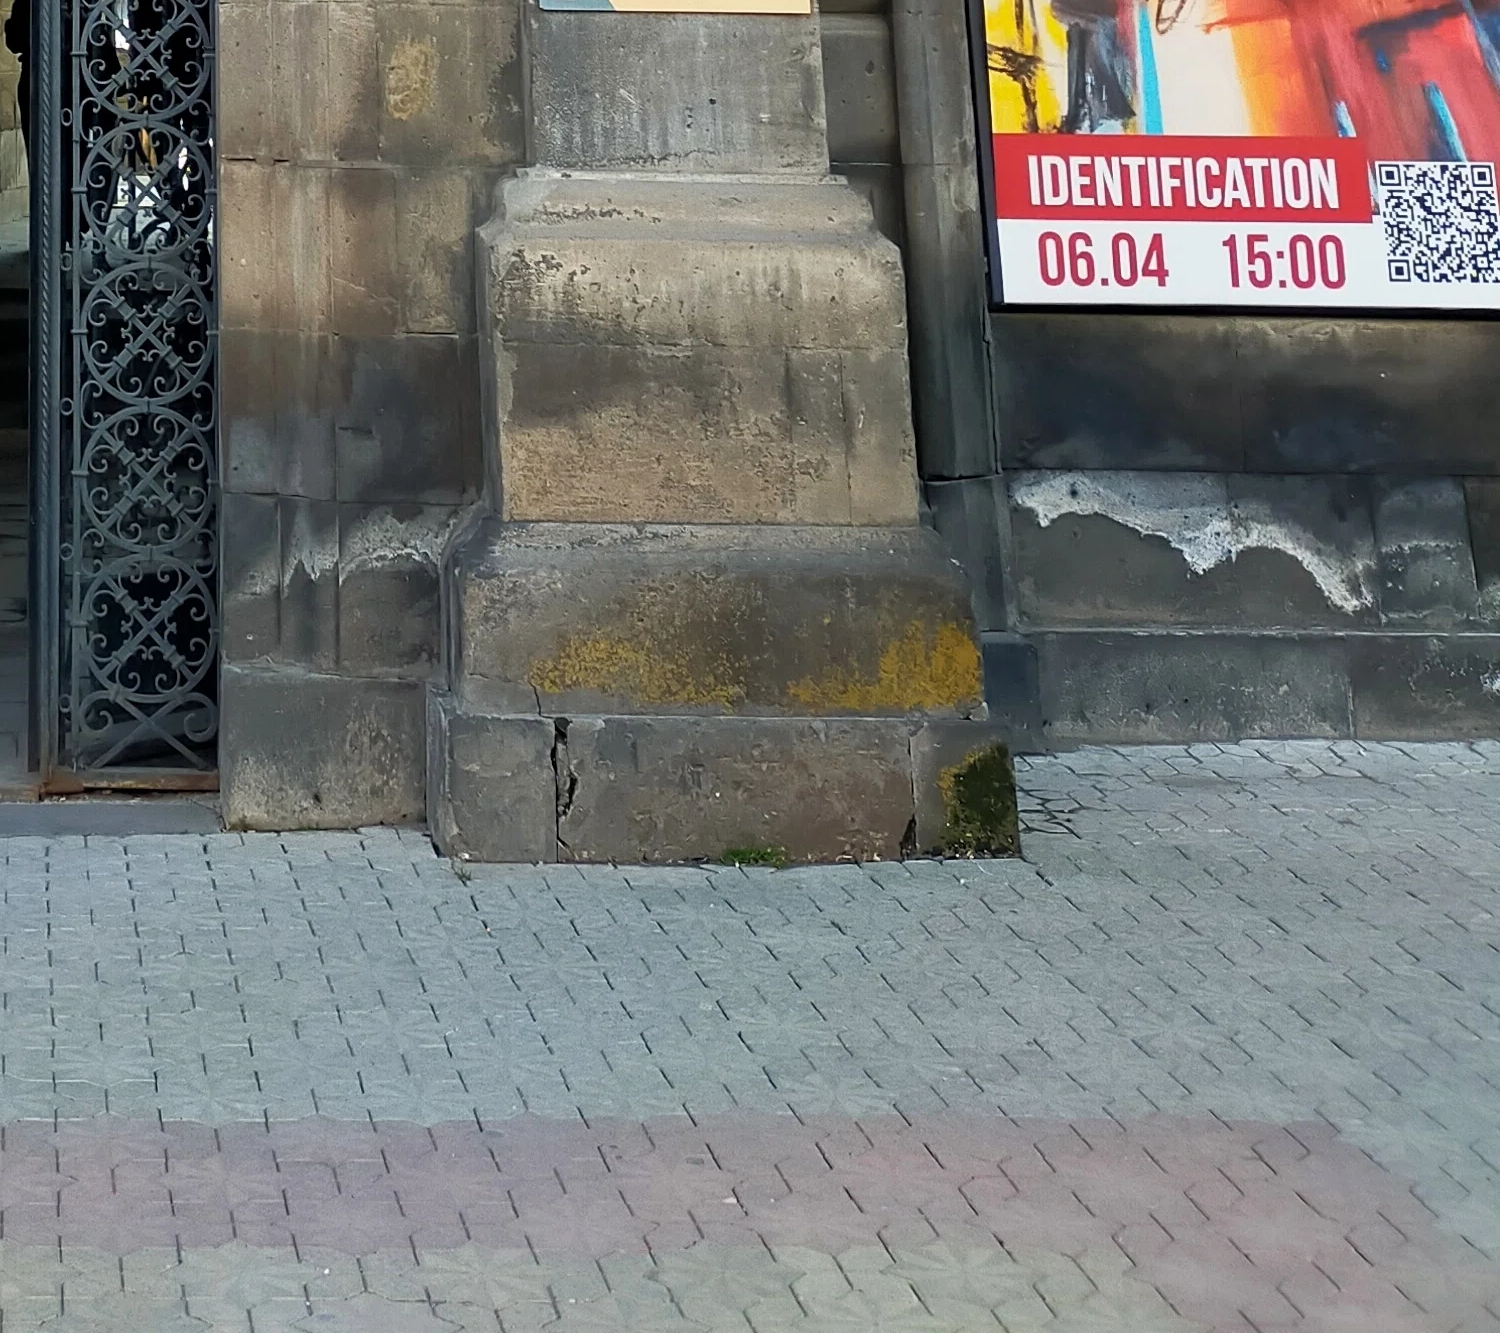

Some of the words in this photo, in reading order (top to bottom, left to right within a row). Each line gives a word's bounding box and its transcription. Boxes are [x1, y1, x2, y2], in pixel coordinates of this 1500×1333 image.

[1027, 154, 1340, 209] IDENTIFICATION
[1038, 231, 1170, 288] 06.04
[1222, 233, 1347, 290] 15:00
